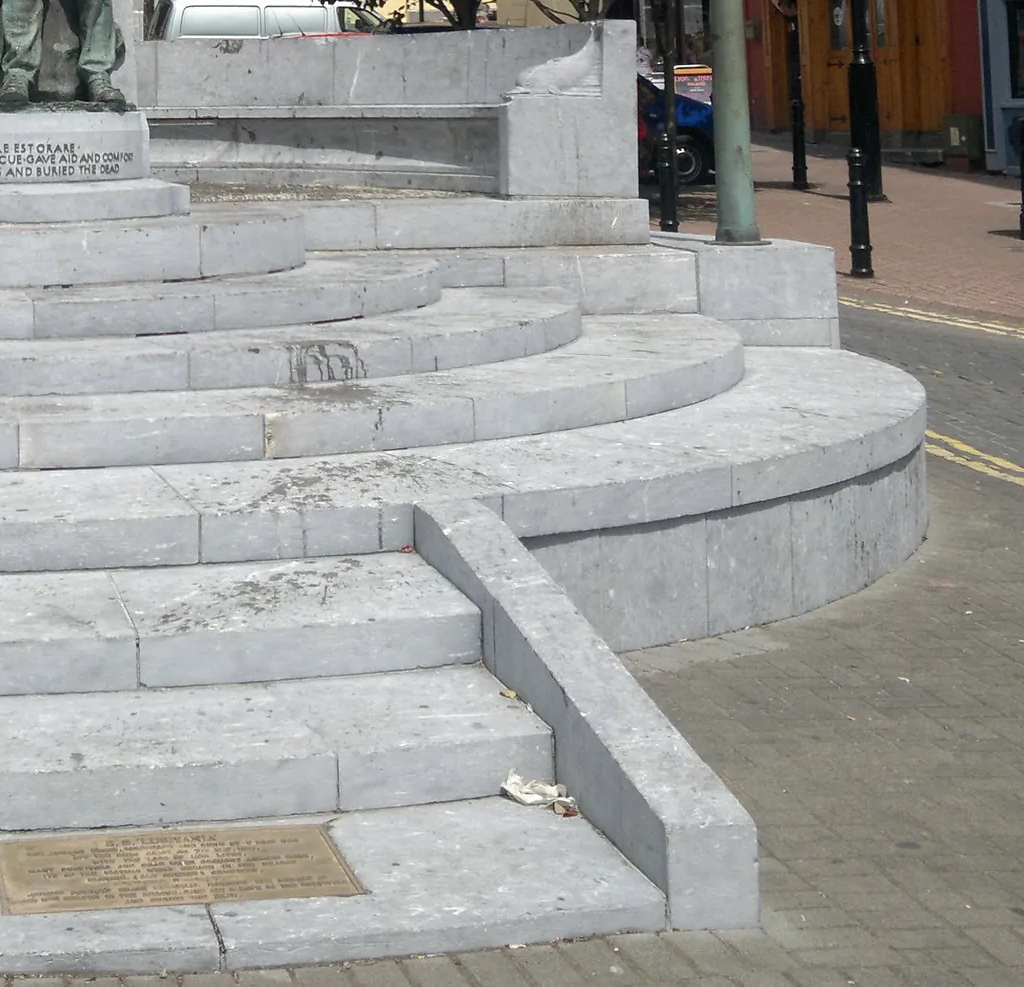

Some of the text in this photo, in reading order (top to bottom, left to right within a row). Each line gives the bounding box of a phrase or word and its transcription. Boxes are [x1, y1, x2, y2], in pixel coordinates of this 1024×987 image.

[14, 143, 34, 154] EST
[37, 143, 75, 154] ORARE
[59, 154, 77, 164] AID
[79, 153, 101, 164] AND
[5, 166, 33, 177] AND
[36, 165, 75, 176] BURIED
[79, 164, 97, 175] THE
[99, 163, 120, 175] DEAD
